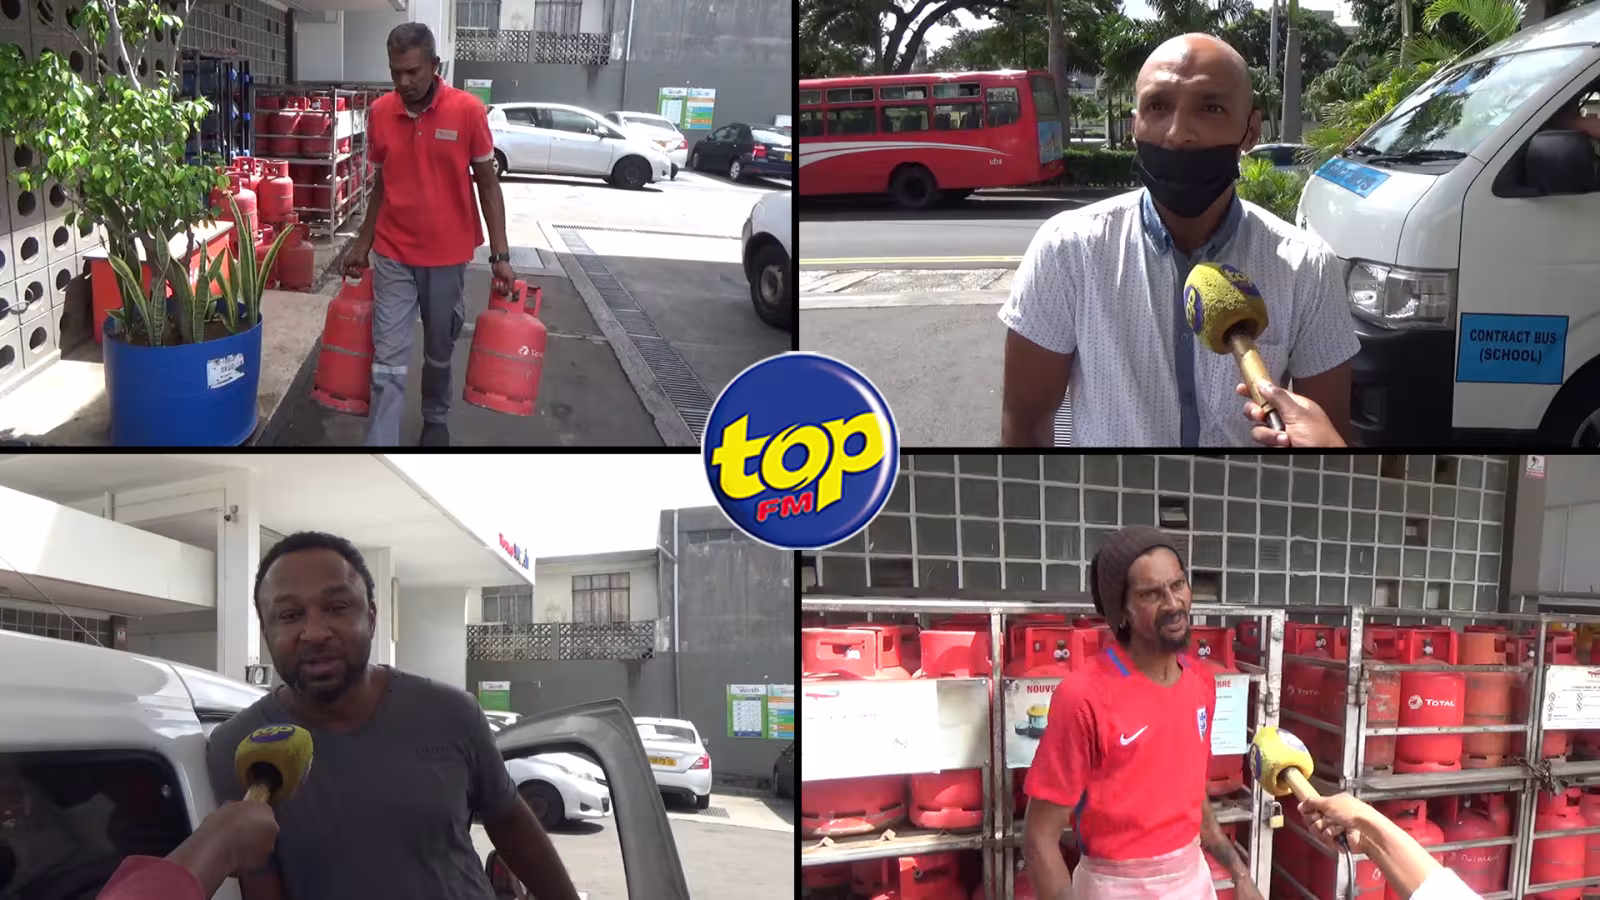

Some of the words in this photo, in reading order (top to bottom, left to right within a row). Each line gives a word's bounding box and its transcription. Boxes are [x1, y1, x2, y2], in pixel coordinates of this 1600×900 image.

[1470, 329, 1531, 344] CONTRACT
[1534, 331, 1557, 344] BUS
[1480, 347, 1542, 365] (SCHOOL)
[1425, 698, 1456, 708] TOTAL
